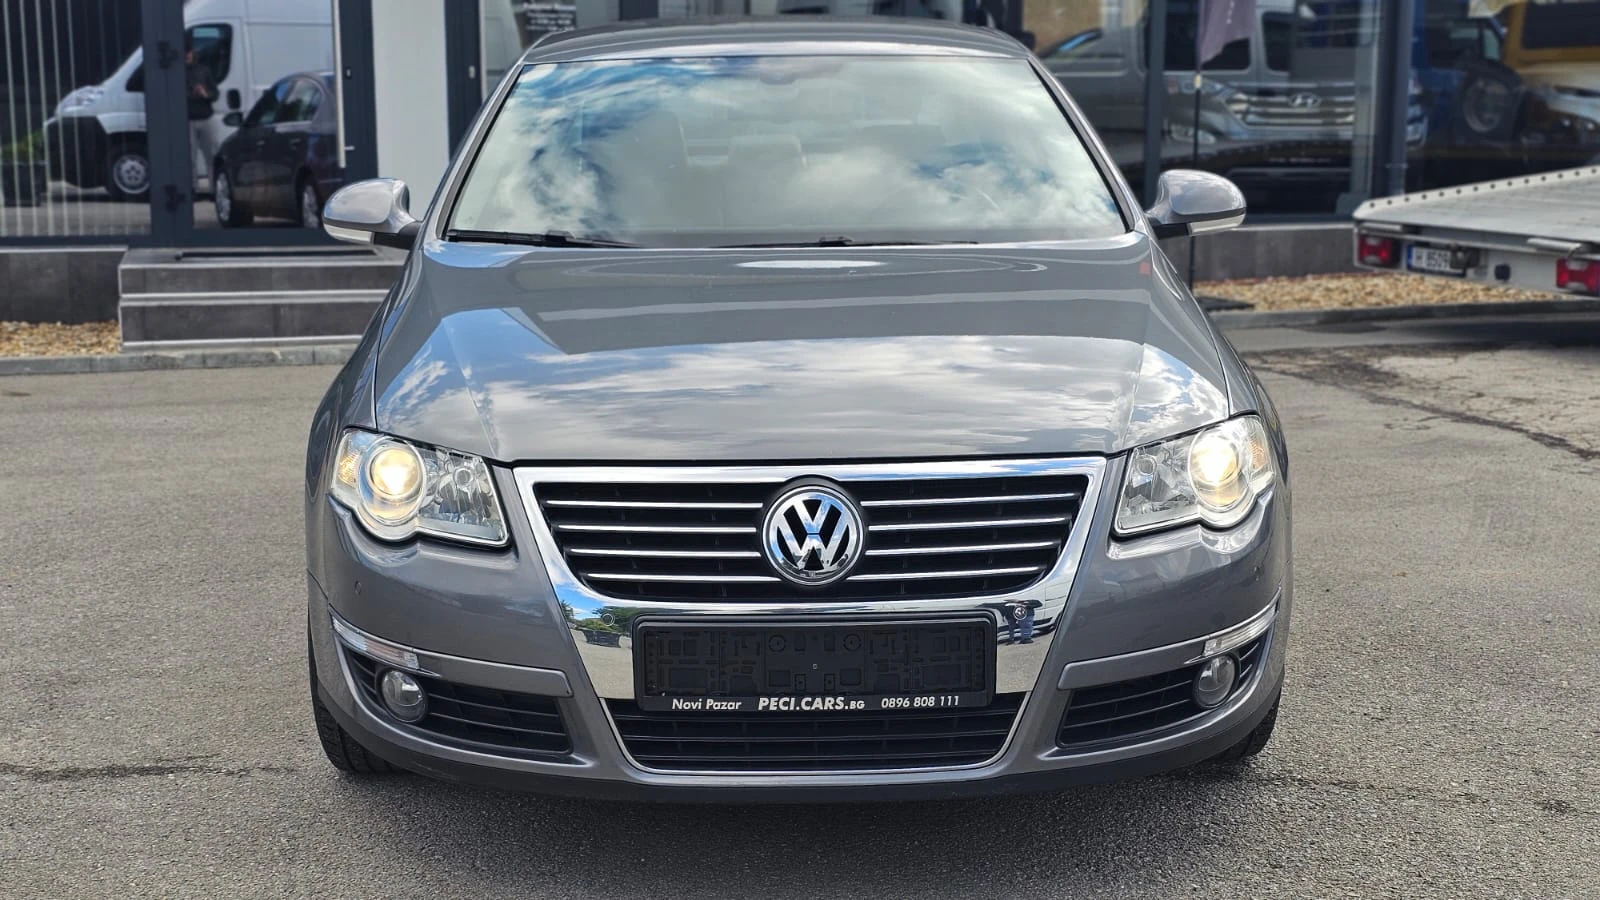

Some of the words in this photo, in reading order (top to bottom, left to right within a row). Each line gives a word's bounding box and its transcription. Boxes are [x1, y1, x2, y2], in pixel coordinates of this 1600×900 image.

[672, 698, 702, 710] Novi
[706, 698, 742, 710] Pazar
[758, 697, 865, 711] PECI.CARS.BG
[881, 698, 910, 709] 0896
[913, 696, 935, 707] 808
[940, 695, 959, 706] 111
